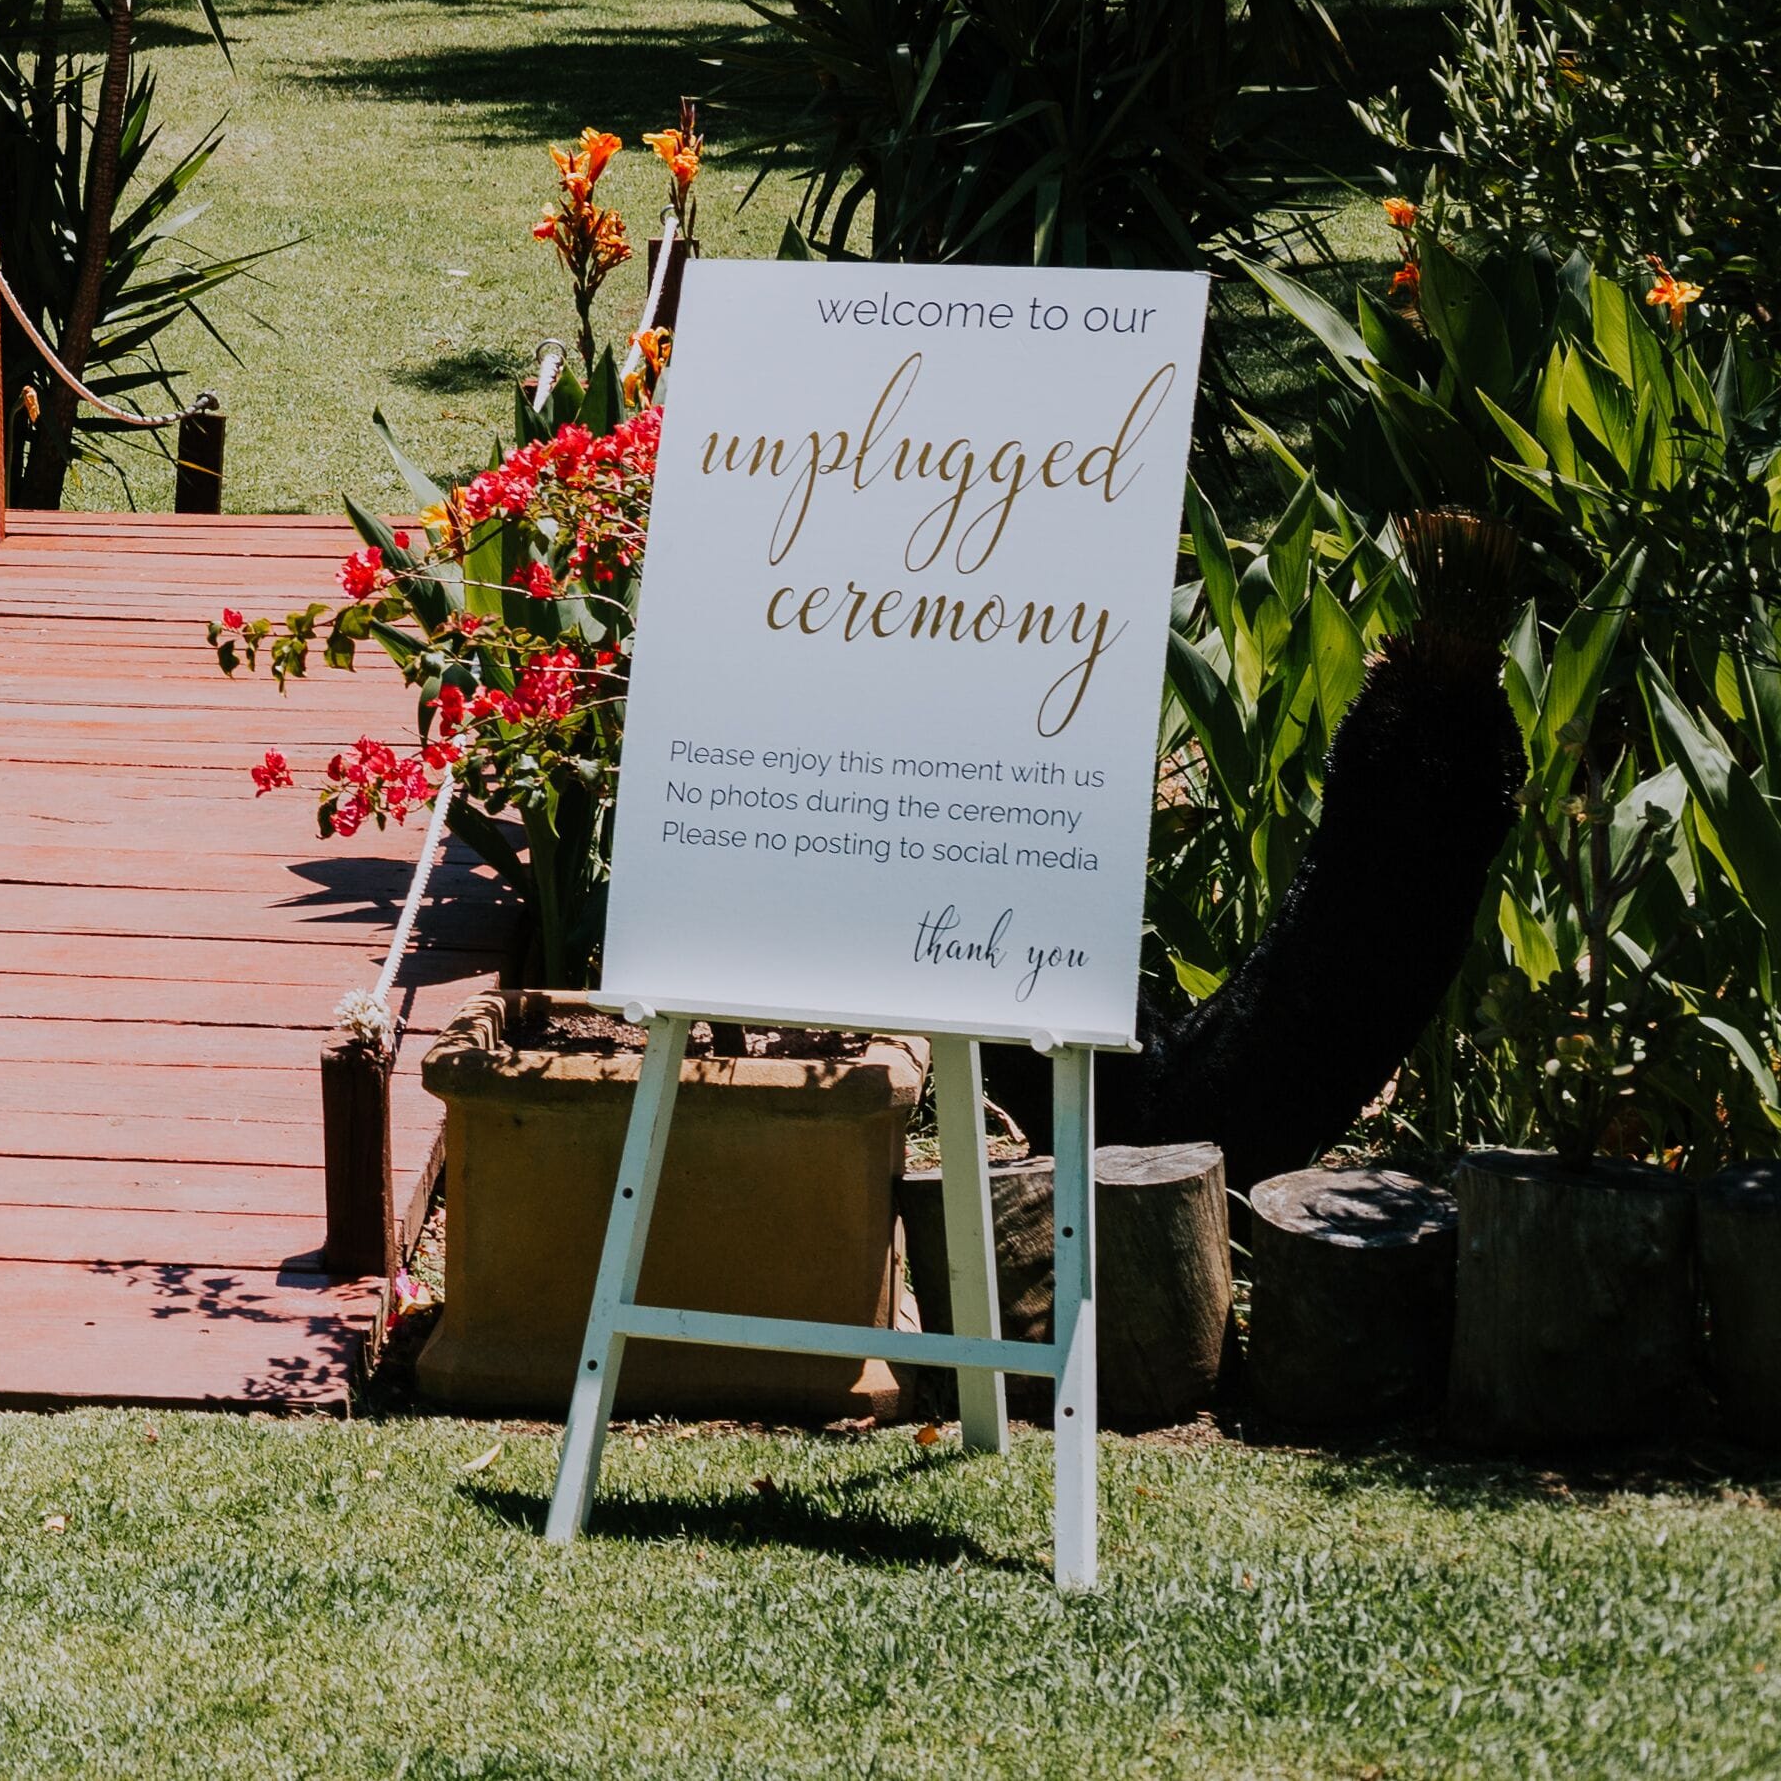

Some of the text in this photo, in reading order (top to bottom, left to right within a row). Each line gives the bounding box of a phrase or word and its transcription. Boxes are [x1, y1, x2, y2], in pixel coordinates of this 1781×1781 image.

[817, 290, 1157, 334] welcome to our
[701, 352, 1177, 575] unplugged
[766, 580, 1130, 738] ceremony
[670, 740, 1105, 788] Please enjoy this moment with us
[666, 780, 1083, 834] No photos during the ceremony
[662, 820, 1099, 871] Please no posting to social media
[913, 904, 1090, 1003] thank you
